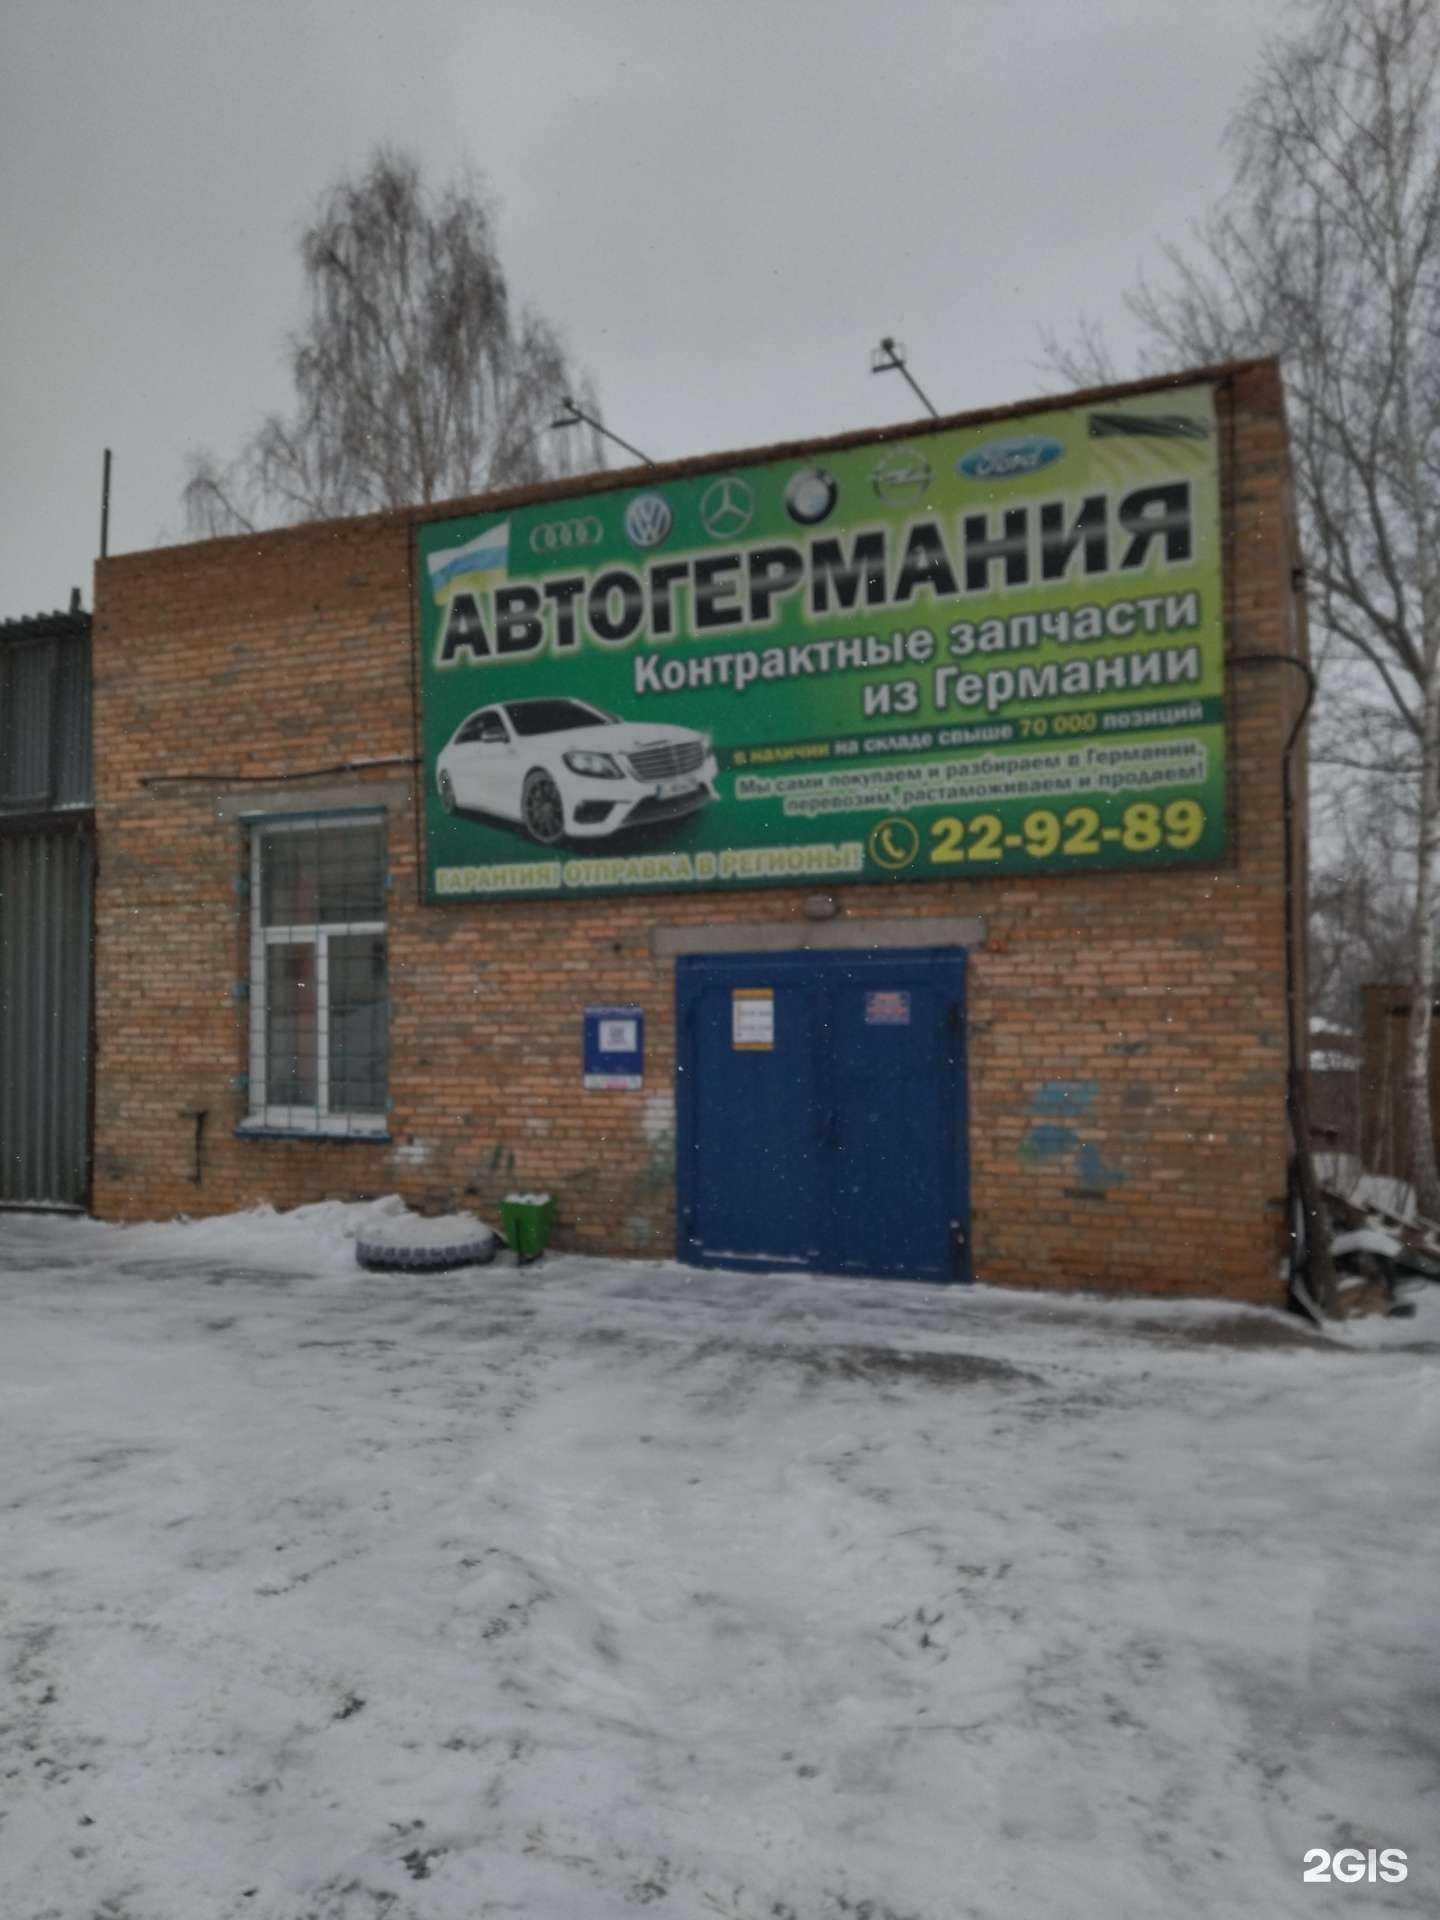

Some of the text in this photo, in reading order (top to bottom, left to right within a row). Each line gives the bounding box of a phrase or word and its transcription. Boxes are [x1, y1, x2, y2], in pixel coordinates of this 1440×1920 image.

[437, 478, 1194, 664] АВТОГЕРМАНИЯ
[634, 593, 1198, 694] Контрактные запчасти
[863, 647, 1199, 715] из Германии
[750, 743, 830, 763] наличии
[834, 740, 859, 755] на
[863, 733, 933, 753] складе
[938, 724, 1013, 746] свыше
[1019, 718, 1048, 736] 70
[1053, 712, 1098, 734] 000
[1102, 700, 1203, 729] позиций
[739, 778, 770, 794] Мы
[776, 774, 823, 792] сами
[829, 766, 923, 789] покупаем
[928, 766, 940, 778] и
[946, 755, 1061, 779] разбираем
[1067, 754, 1081, 767] в
[903, 778, 1071, 805] растаможиваем
[1077, 776, 1091, 787] и
[1098, 763, 1203, 788] продаем!
[930, 799, 1204, 864] 22-92-89
[565, 854, 690, 884] ОТПРАВКА
[698, 853, 714, 877] В
